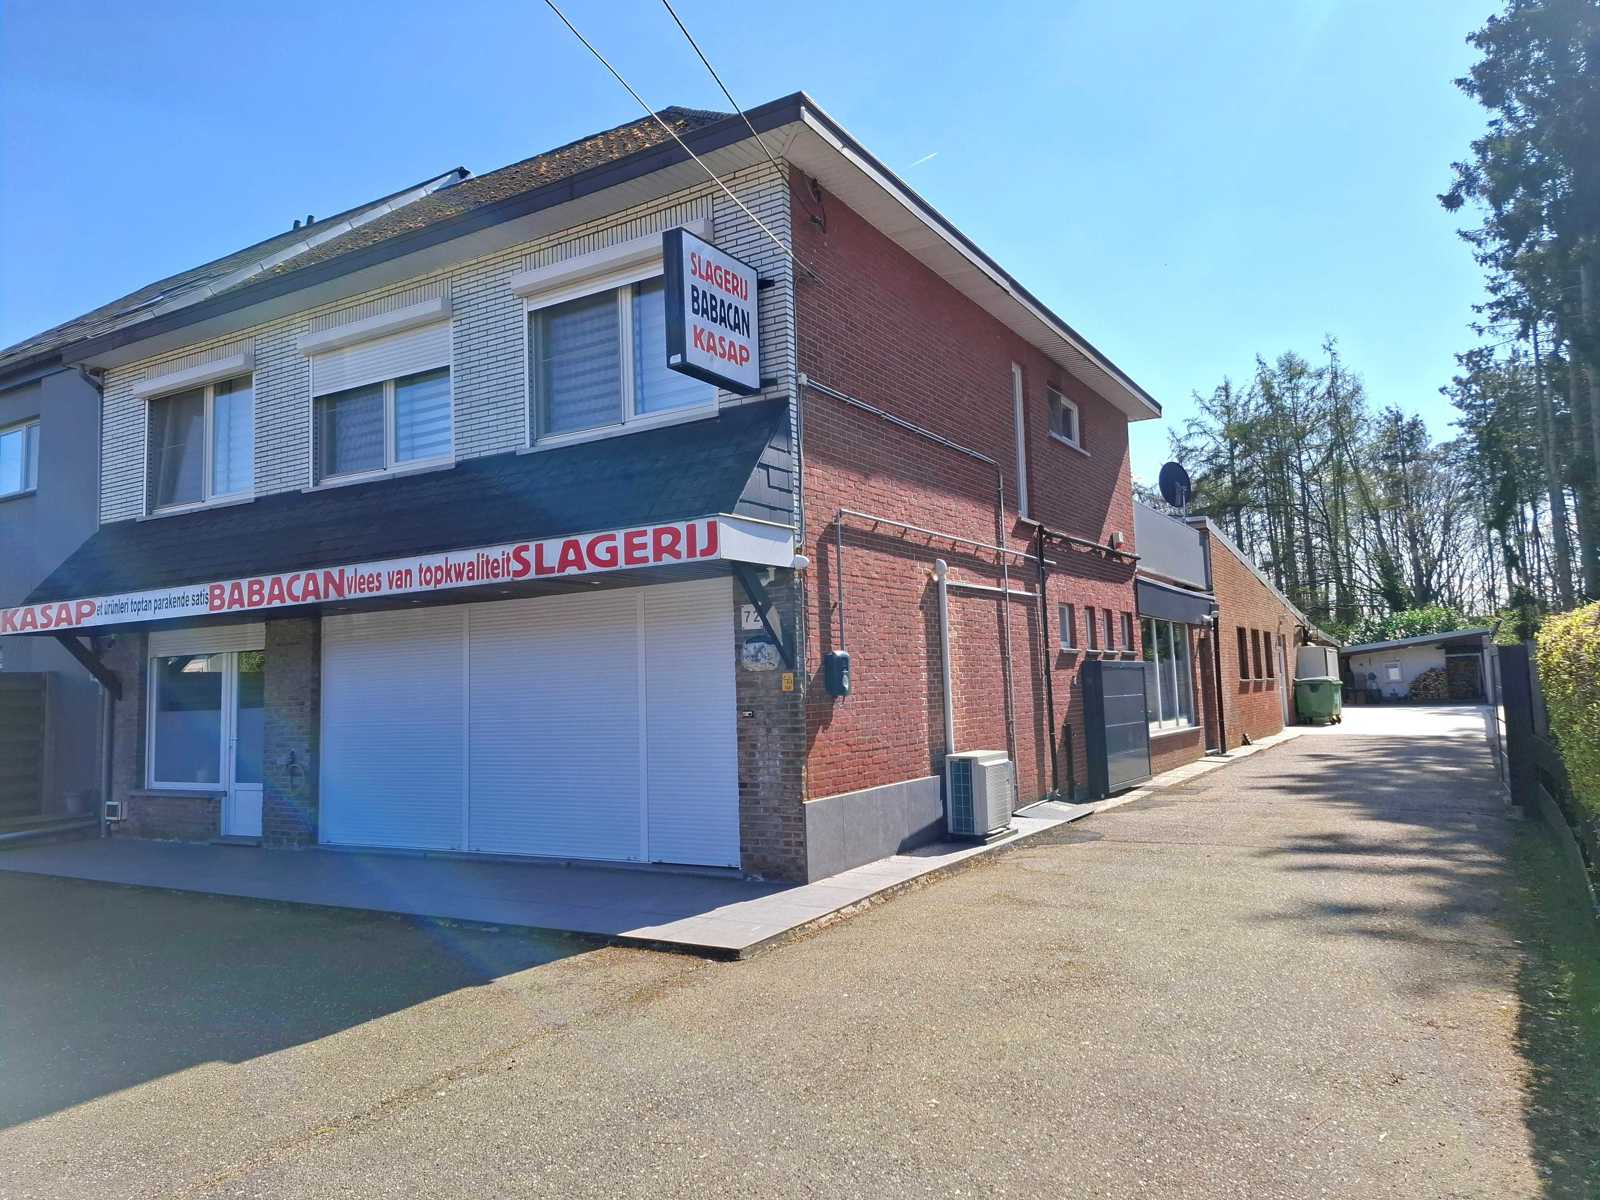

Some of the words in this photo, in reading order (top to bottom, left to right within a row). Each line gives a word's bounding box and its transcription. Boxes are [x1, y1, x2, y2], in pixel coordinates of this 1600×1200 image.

[690, 251, 748, 301] SLAGERIJ
[691, 284, 750, 339] BABACAN
[693, 324, 750, 367] KASAP
[2, 600, 96, 633] KASAP
[97, 600, 103, 616] et
[130, 596, 152, 616] toptan
[153, 592, 190, 614] parakende
[209, 568, 346, 612] BABACAN
[346, 567, 382, 594] vlees
[387, 568, 413, 590] van
[418, 551, 512, 588] topkwaliteit
[511, 520, 719, 577] SLAGERIJ
